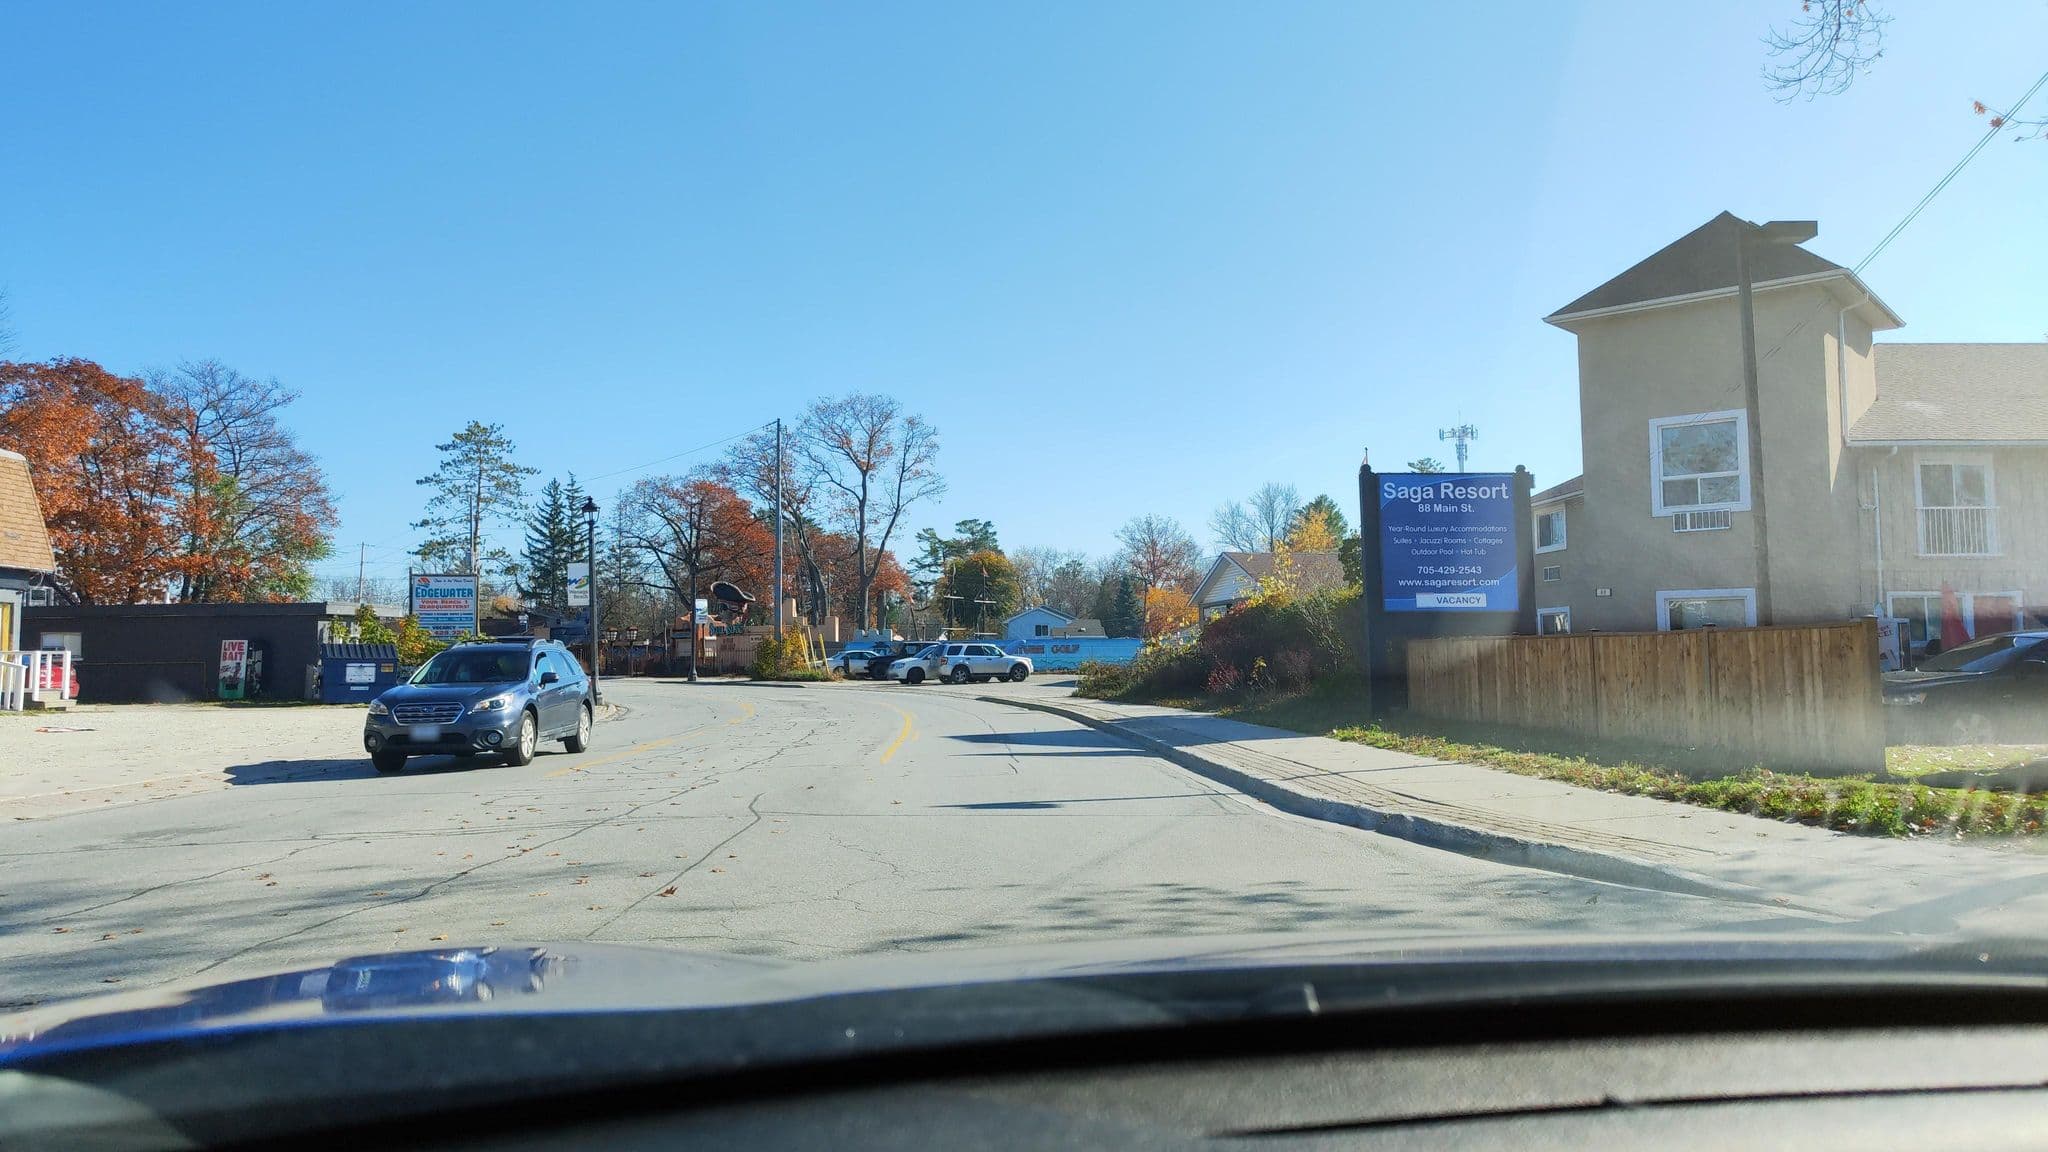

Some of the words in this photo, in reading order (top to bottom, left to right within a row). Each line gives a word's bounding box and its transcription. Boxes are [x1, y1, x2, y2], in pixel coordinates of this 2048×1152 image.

[1383, 482, 1434, 503] Saga
[1440, 482, 1510, 499] Resort
[1418, 503, 1431, 513] 88
[1433, 503, 1459, 513] Main
[1460, 503, 1475, 513] St.
[1388, 525, 1427, 533] Year-Round
[1427, 525, 1449, 534] Luxury
[1450, 525, 1508, 533] Accommodations
[1393, 537, 1413, 545] Suites
[1419, 537, 1442, 545] Jacuzzi
[1443, 537, 1467, 545] Rooms
[1473, 537, 1504, 546] Cottages
[1411, 548, 1438, 556] Outdoor
[1438, 548, 1454, 556] Pool
[1460, 548, 1473, 556] Hot
[1473, 548, 1487, 556] Tub
[1417, 566, 1482, 575] 705-429-2543
[1398, 578, 1500, 588] www.sagaresort.com
[416, 586, 474, 598] EDGEWATER
[1436, 596, 1481, 604] VACANCY
[223, 641, 245, 651] LIVE
[222, 651, 244, 661] BAIT
